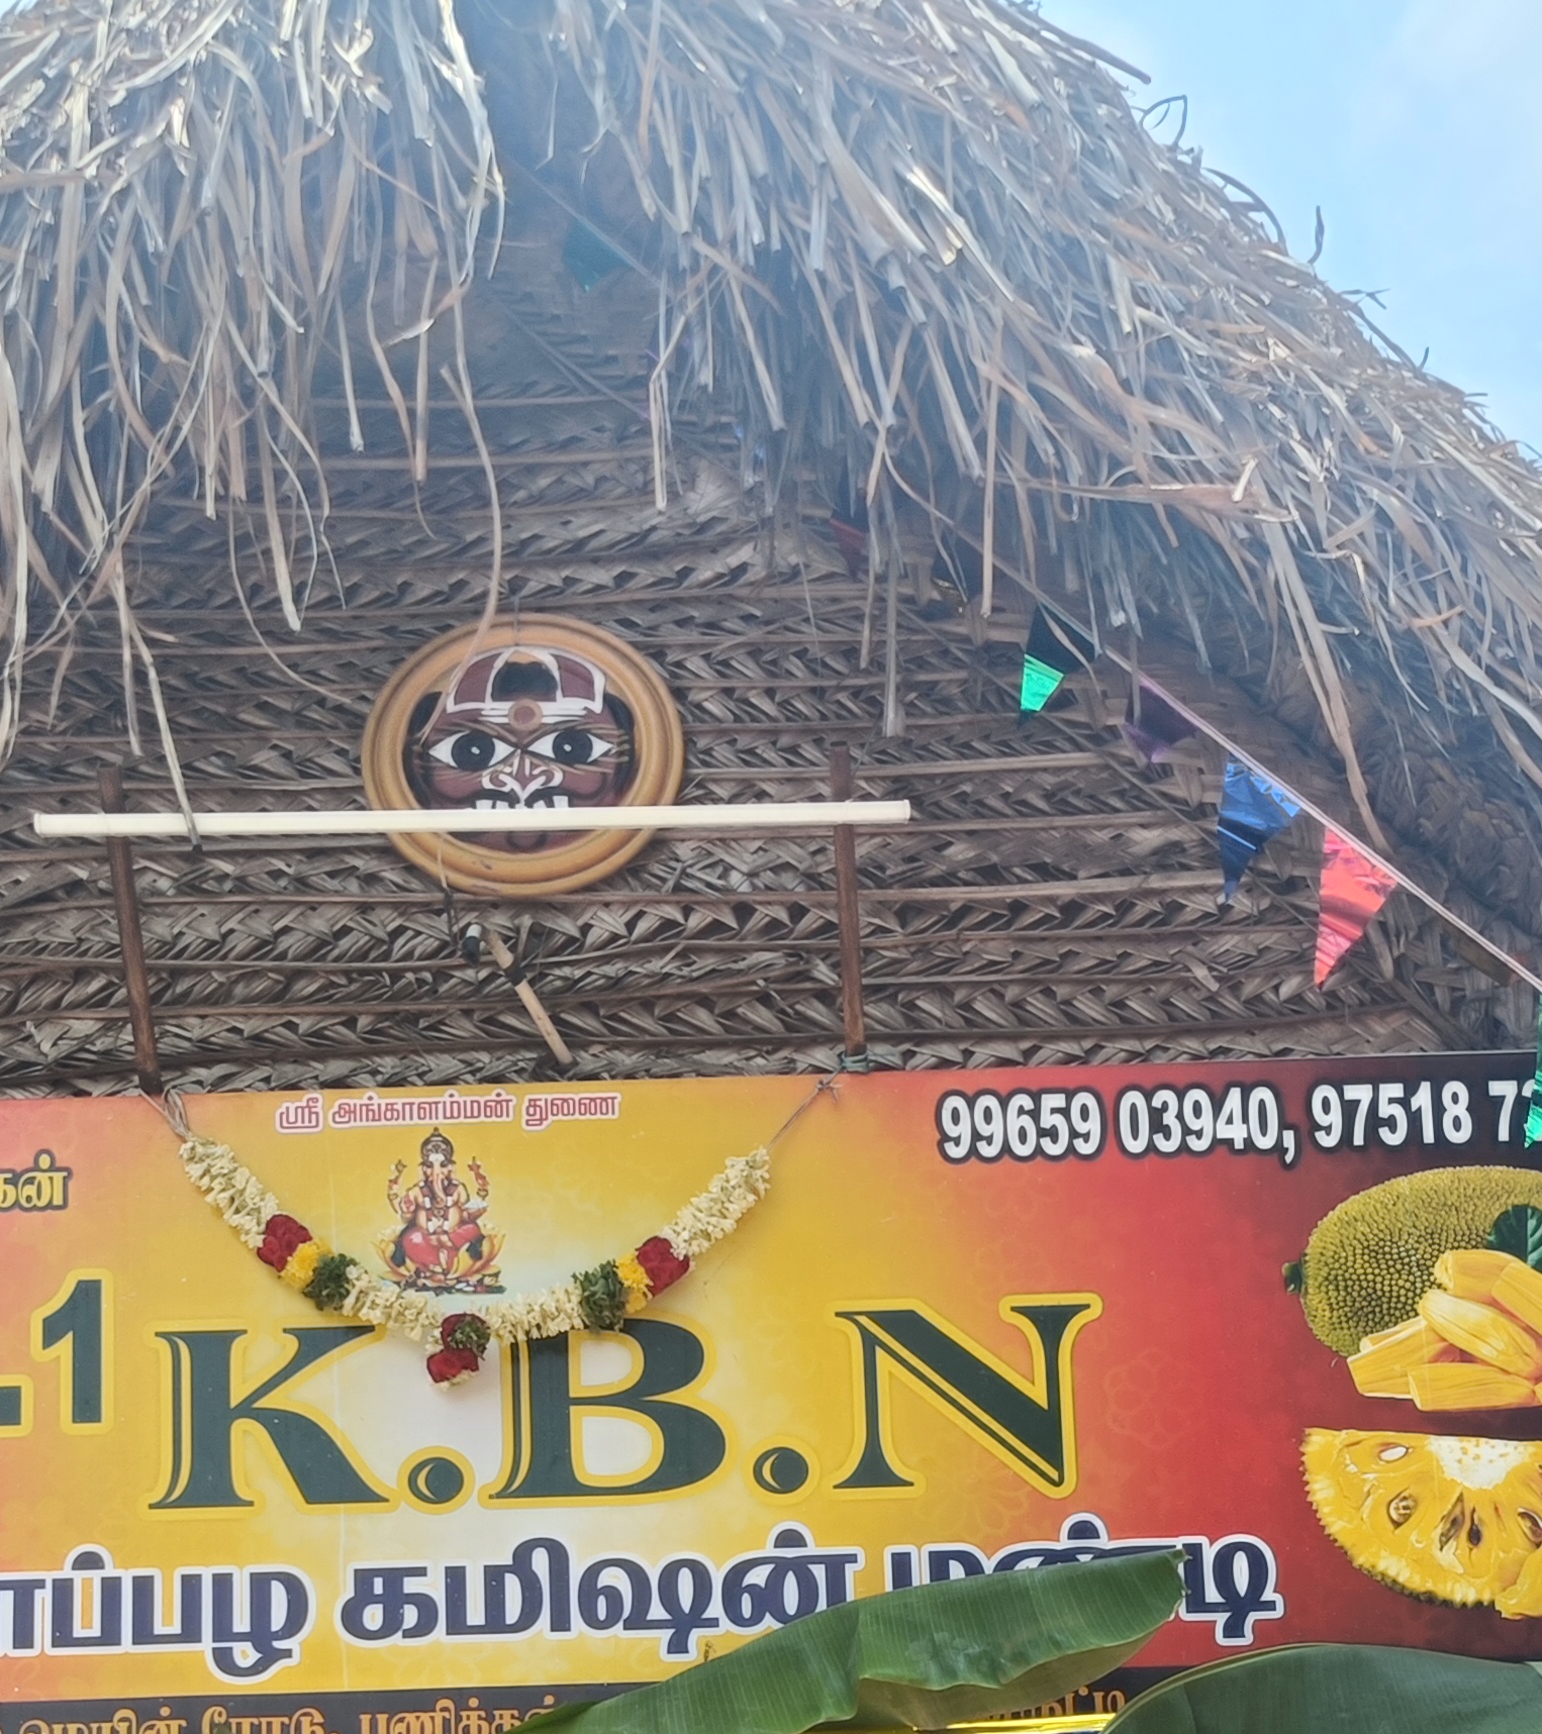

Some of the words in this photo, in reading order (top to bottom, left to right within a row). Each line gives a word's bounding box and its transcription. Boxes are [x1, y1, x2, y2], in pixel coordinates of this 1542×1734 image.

[524, 1095, 619, 1128] துணை
[941, 1091, 1103, 1162] 99659
[1119, 1085, 1296, 1163] 03940,
[1310, 1080, 1473, 1147] 97518
[341, 1525, 859, 1658] கமிஷன்
